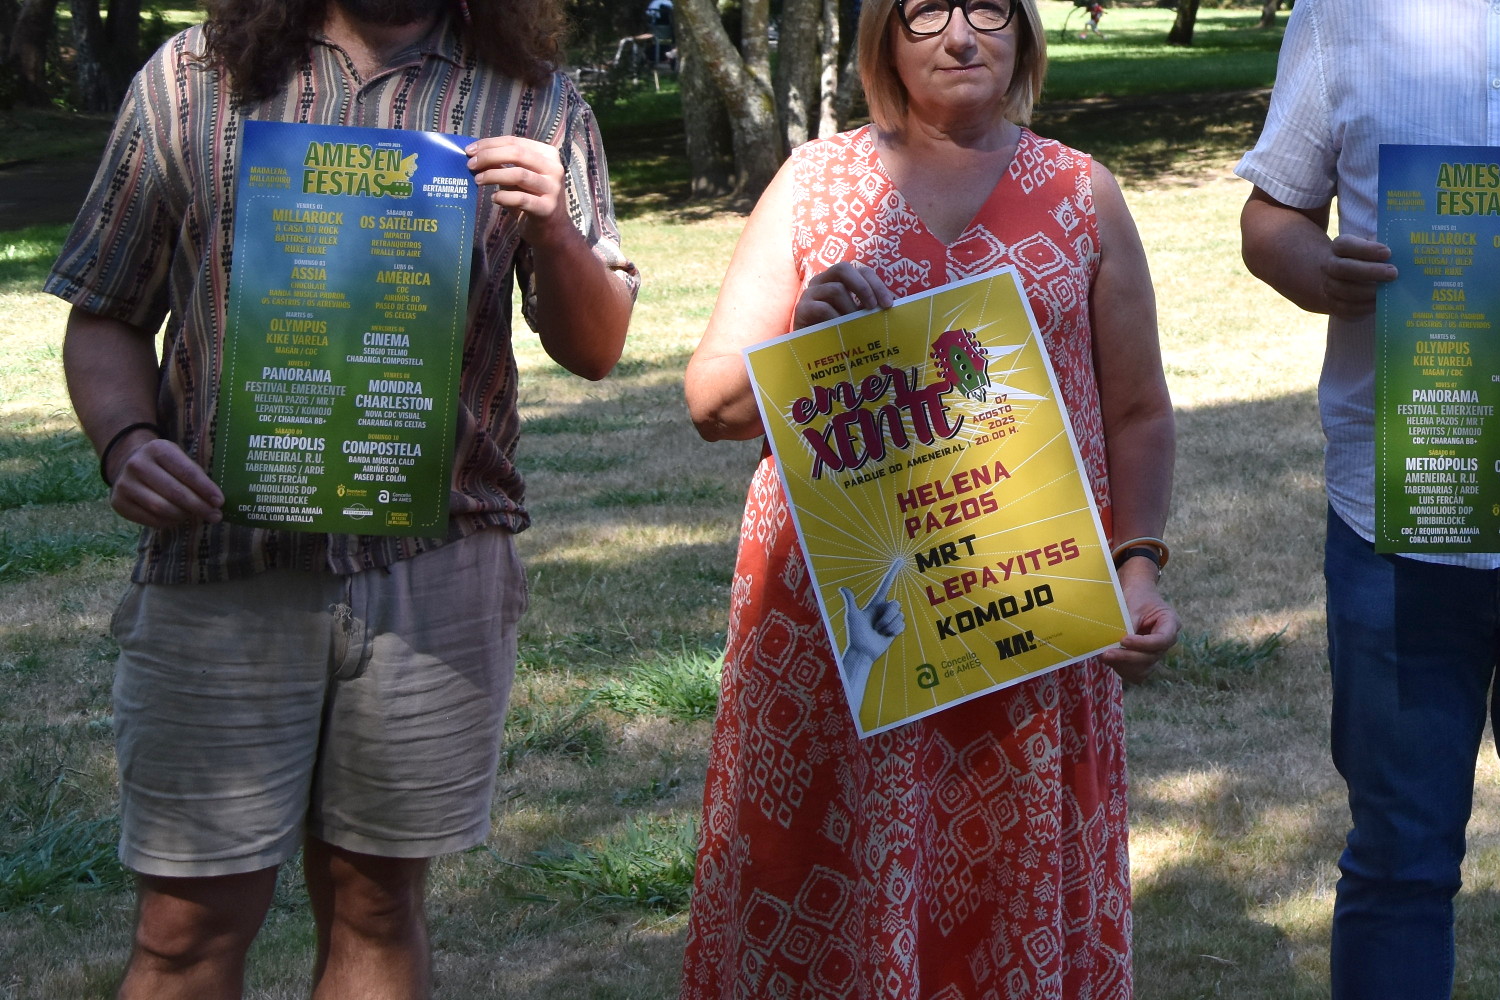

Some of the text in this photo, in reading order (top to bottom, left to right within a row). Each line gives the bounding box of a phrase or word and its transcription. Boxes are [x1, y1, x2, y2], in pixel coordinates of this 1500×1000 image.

[303, 141, 402, 172] AMES EN
[302, 169, 387, 198] FESTAS
[1435, 162, 1500, 189] AMES
[272, 208, 344, 225] MILLAROCK
[359, 216, 375, 229] OS
[1409, 231, 1478, 246] MILLAROCK
[290, 267, 327, 281] ASSIA
[1431, 288, 1466, 302] ASSIA
[270, 318, 327, 334] OLYMPUS
[266, 332, 329, 346] KIKE VARELA
[363, 332, 410, 348] CINEMA
[813, 346, 865, 369] FESTIVAL
[866, 340, 882, 350] DE
[1415, 340, 1471, 355] OLYMPUS
[810, 346, 900, 382] NOVOS ARTISTAS
[1413, 356, 1473, 367] KIKE VARELA
[262, 366, 332, 383] PANORAMA
[245, 381, 346, 396] FESTIVAL EMERXENTE
[368, 379, 423, 395] MONDRA
[355, 394, 433, 411] CHARLESTON
[994, 393, 1009, 405] 07
[1412, 389, 1479, 403] PANORAMA
[971, 403, 1013, 425] AGOSTO
[1397, 404, 1494, 417] FESTIVAL EMERXENTE
[987, 415, 1016, 431] 2025
[248, 434, 326, 451] METRÓPOLIS
[342, 440, 422, 457] COMPOSTELA
[843, 467, 886, 489] PARQUE
[888, 462, 904, 474] DO
[906, 443, 966, 469] AMENEIRAL
[1405, 455, 1478, 471] METRÓPOLIS
[1404, 472, 1457, 484] AMENEIRAL
[896, 460, 1012, 513] HELENA
[1403, 485, 1453, 495] TABERNARIAS
[1418, 495, 1435, 505] LUIS
[904, 491, 999, 540] PAZOS
[925, 537, 1080, 607] LEPAYITSS
[935, 583, 1054, 641] KOMOJO
[940, 650, 978, 670] Concello
[943, 657, 982, 678] de AMES
